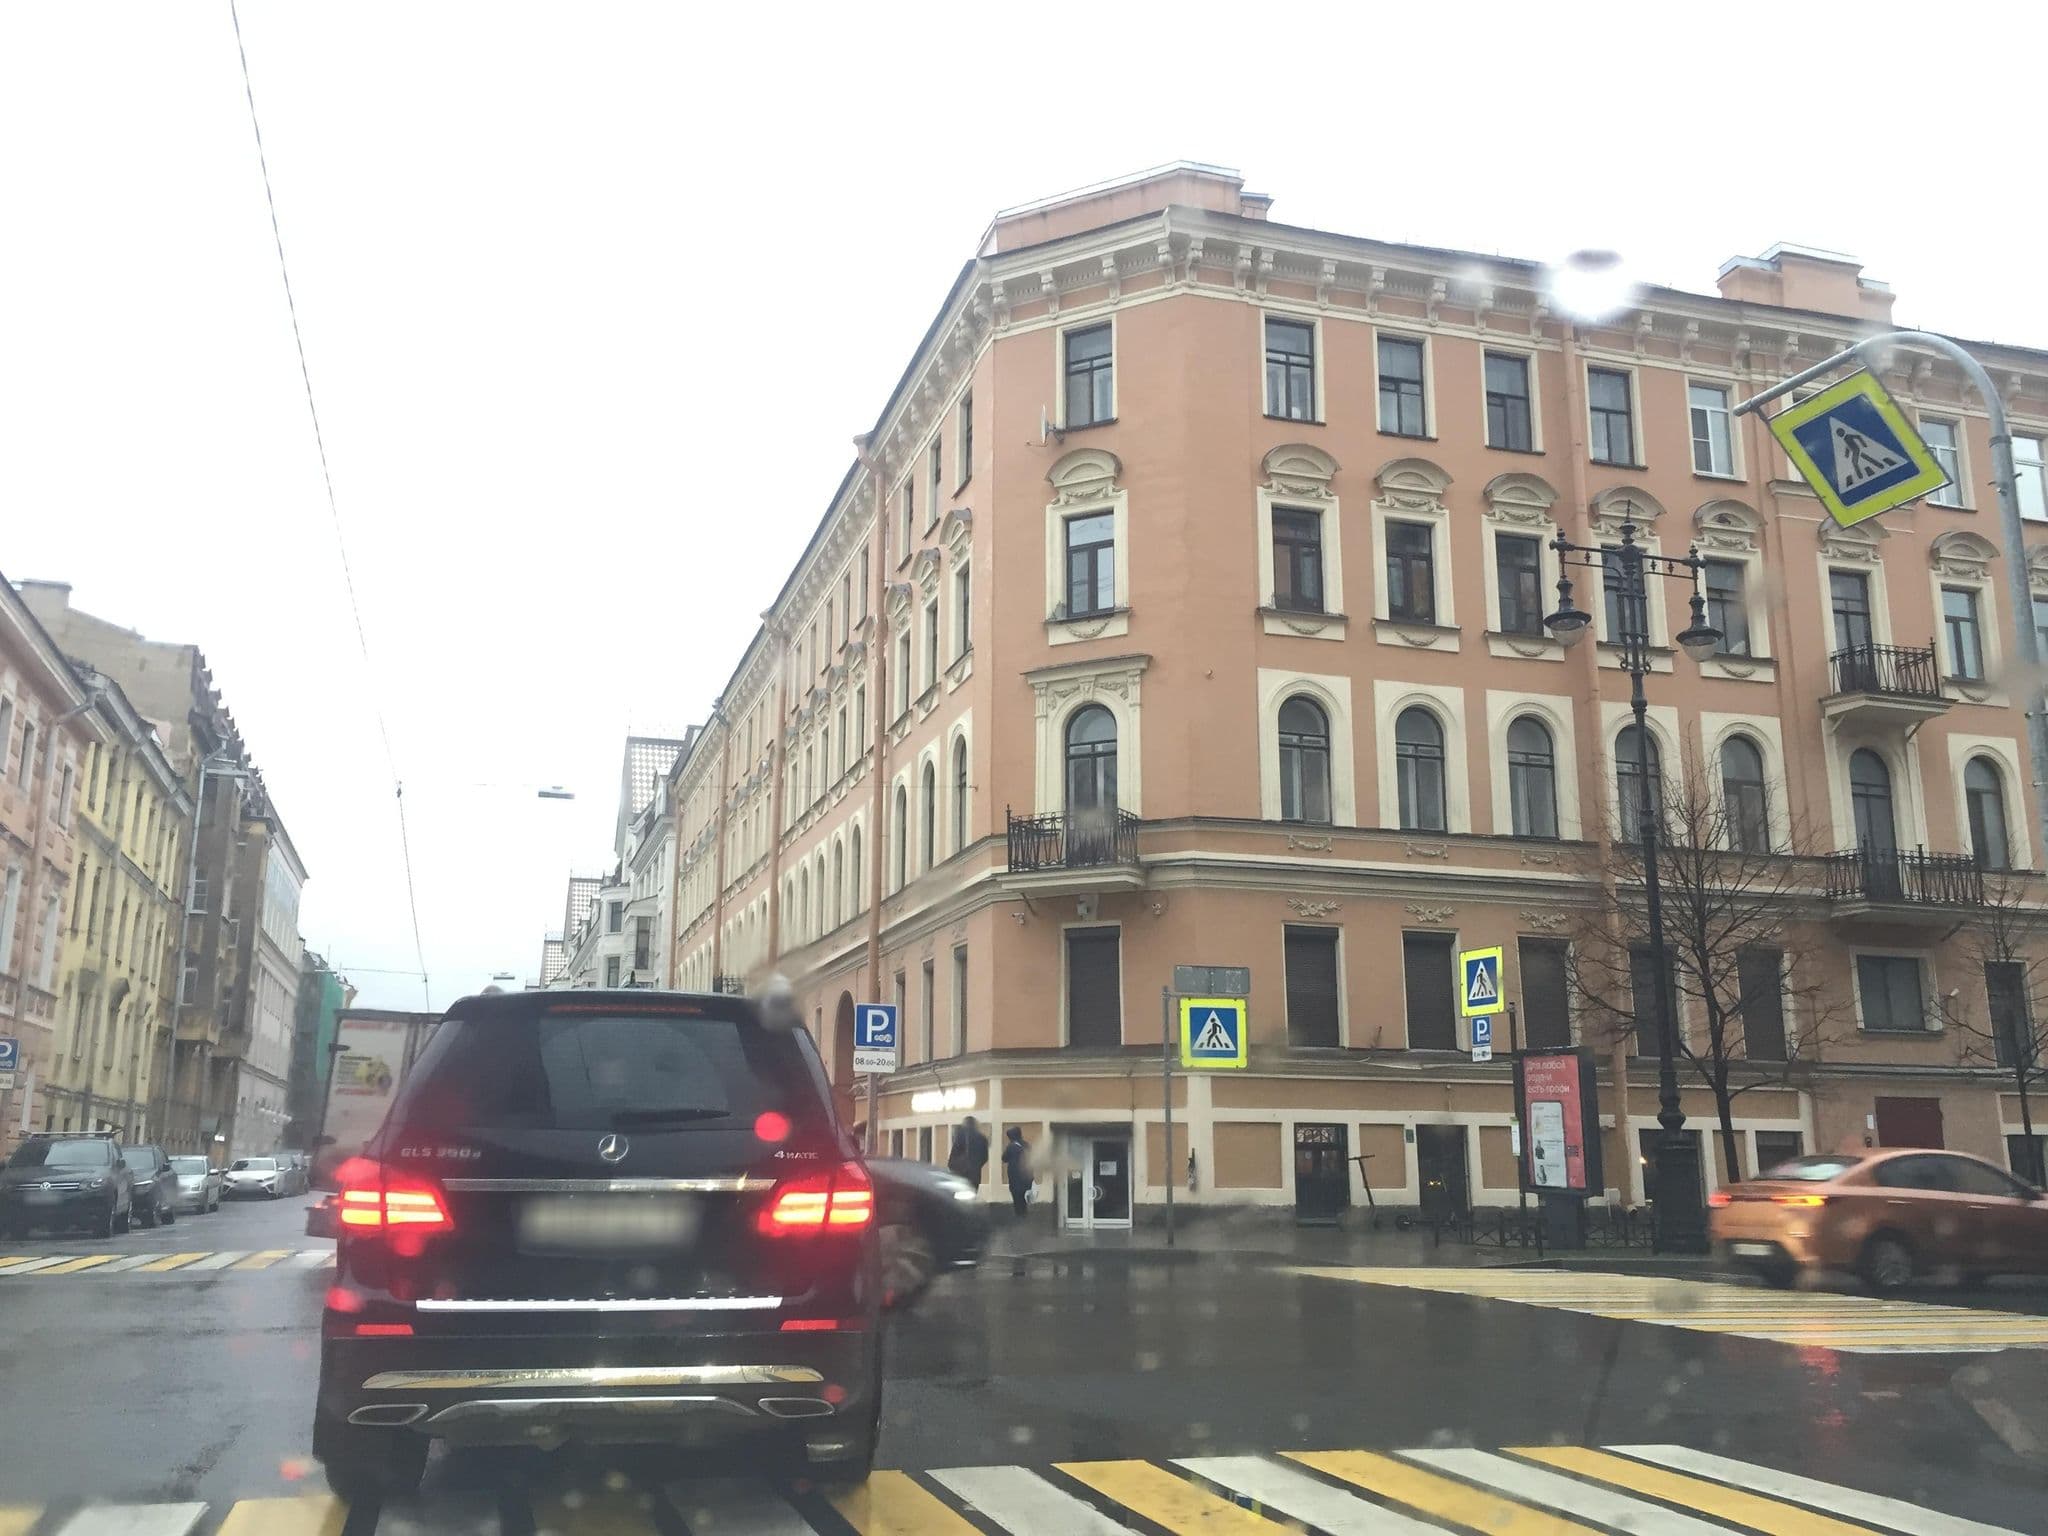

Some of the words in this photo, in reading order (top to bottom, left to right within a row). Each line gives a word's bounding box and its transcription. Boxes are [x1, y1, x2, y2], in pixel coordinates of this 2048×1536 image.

[866, 1009, 890, 1043] P
[1476, 1019, 1488, 1042] P
[401, 1147, 432, 1158] GLS
